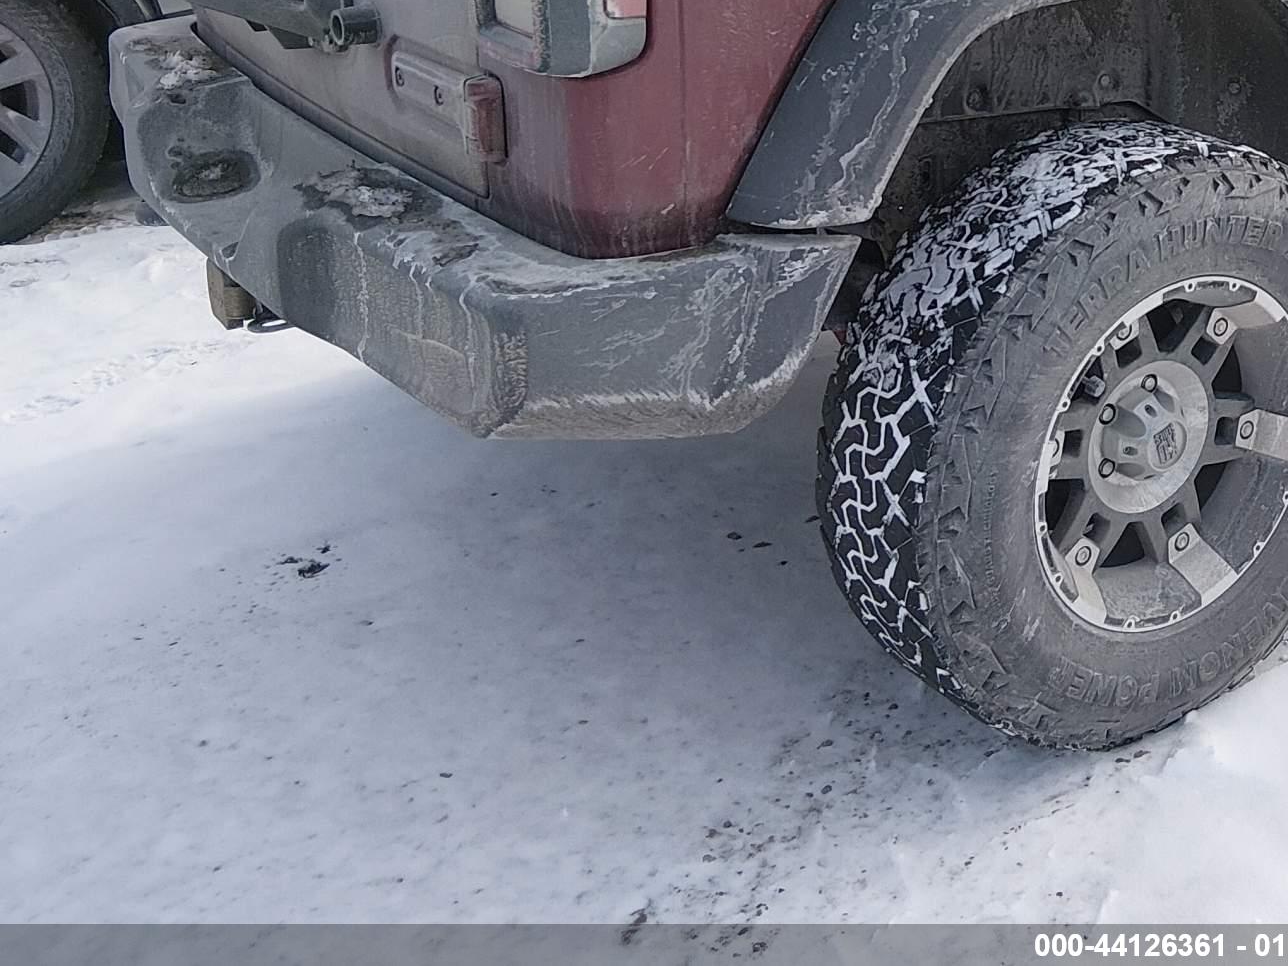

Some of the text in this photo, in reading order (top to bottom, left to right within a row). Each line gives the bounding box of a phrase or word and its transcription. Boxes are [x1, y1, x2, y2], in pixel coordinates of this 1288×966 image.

[1043, 248, 1152, 358] TERRA
[1153, 213, 1283, 262] HUNTER
[1047, 597, 1287, 709] VENOM POWER
